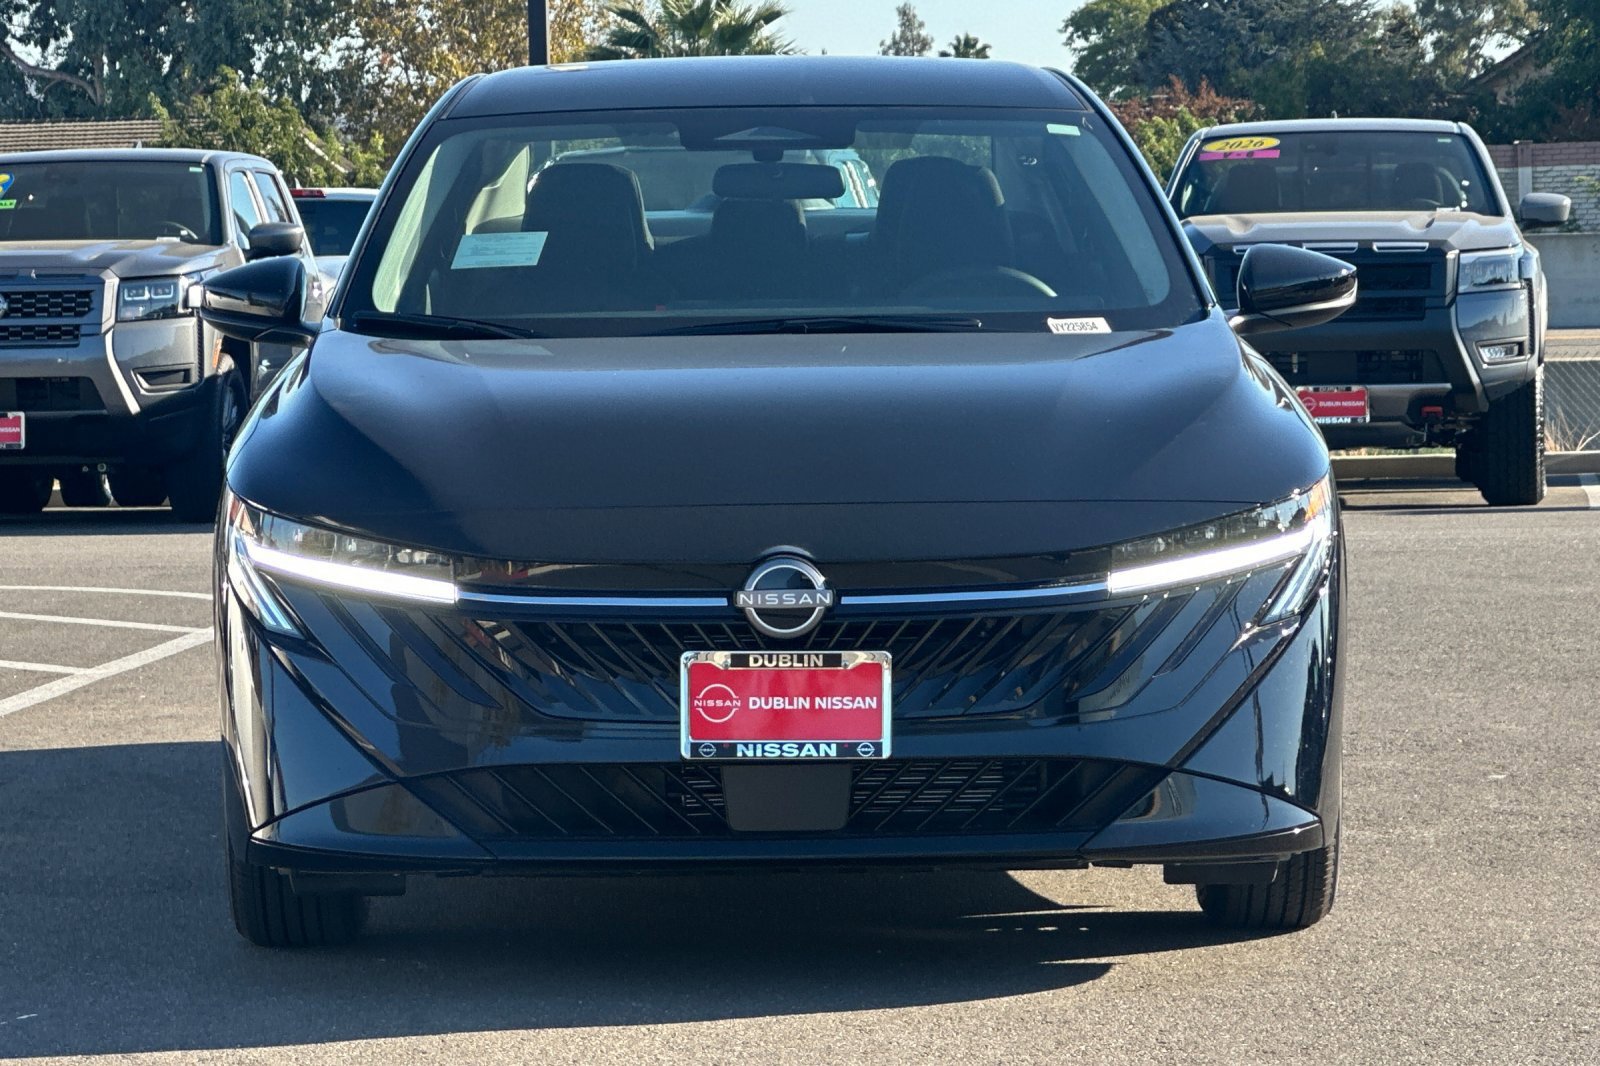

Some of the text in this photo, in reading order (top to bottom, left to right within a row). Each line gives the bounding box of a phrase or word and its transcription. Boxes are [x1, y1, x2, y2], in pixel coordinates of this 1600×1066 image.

[1215, 139, 1265, 151] 2026
[739, 592, 831, 606] NISSAN
[748, 654, 824, 668] DUBLIN
[693, 699, 741, 708] NISSAN
[748, 696, 877, 710] DUBLIN NISSAN
[736, 742, 837, 758] NISSAN
